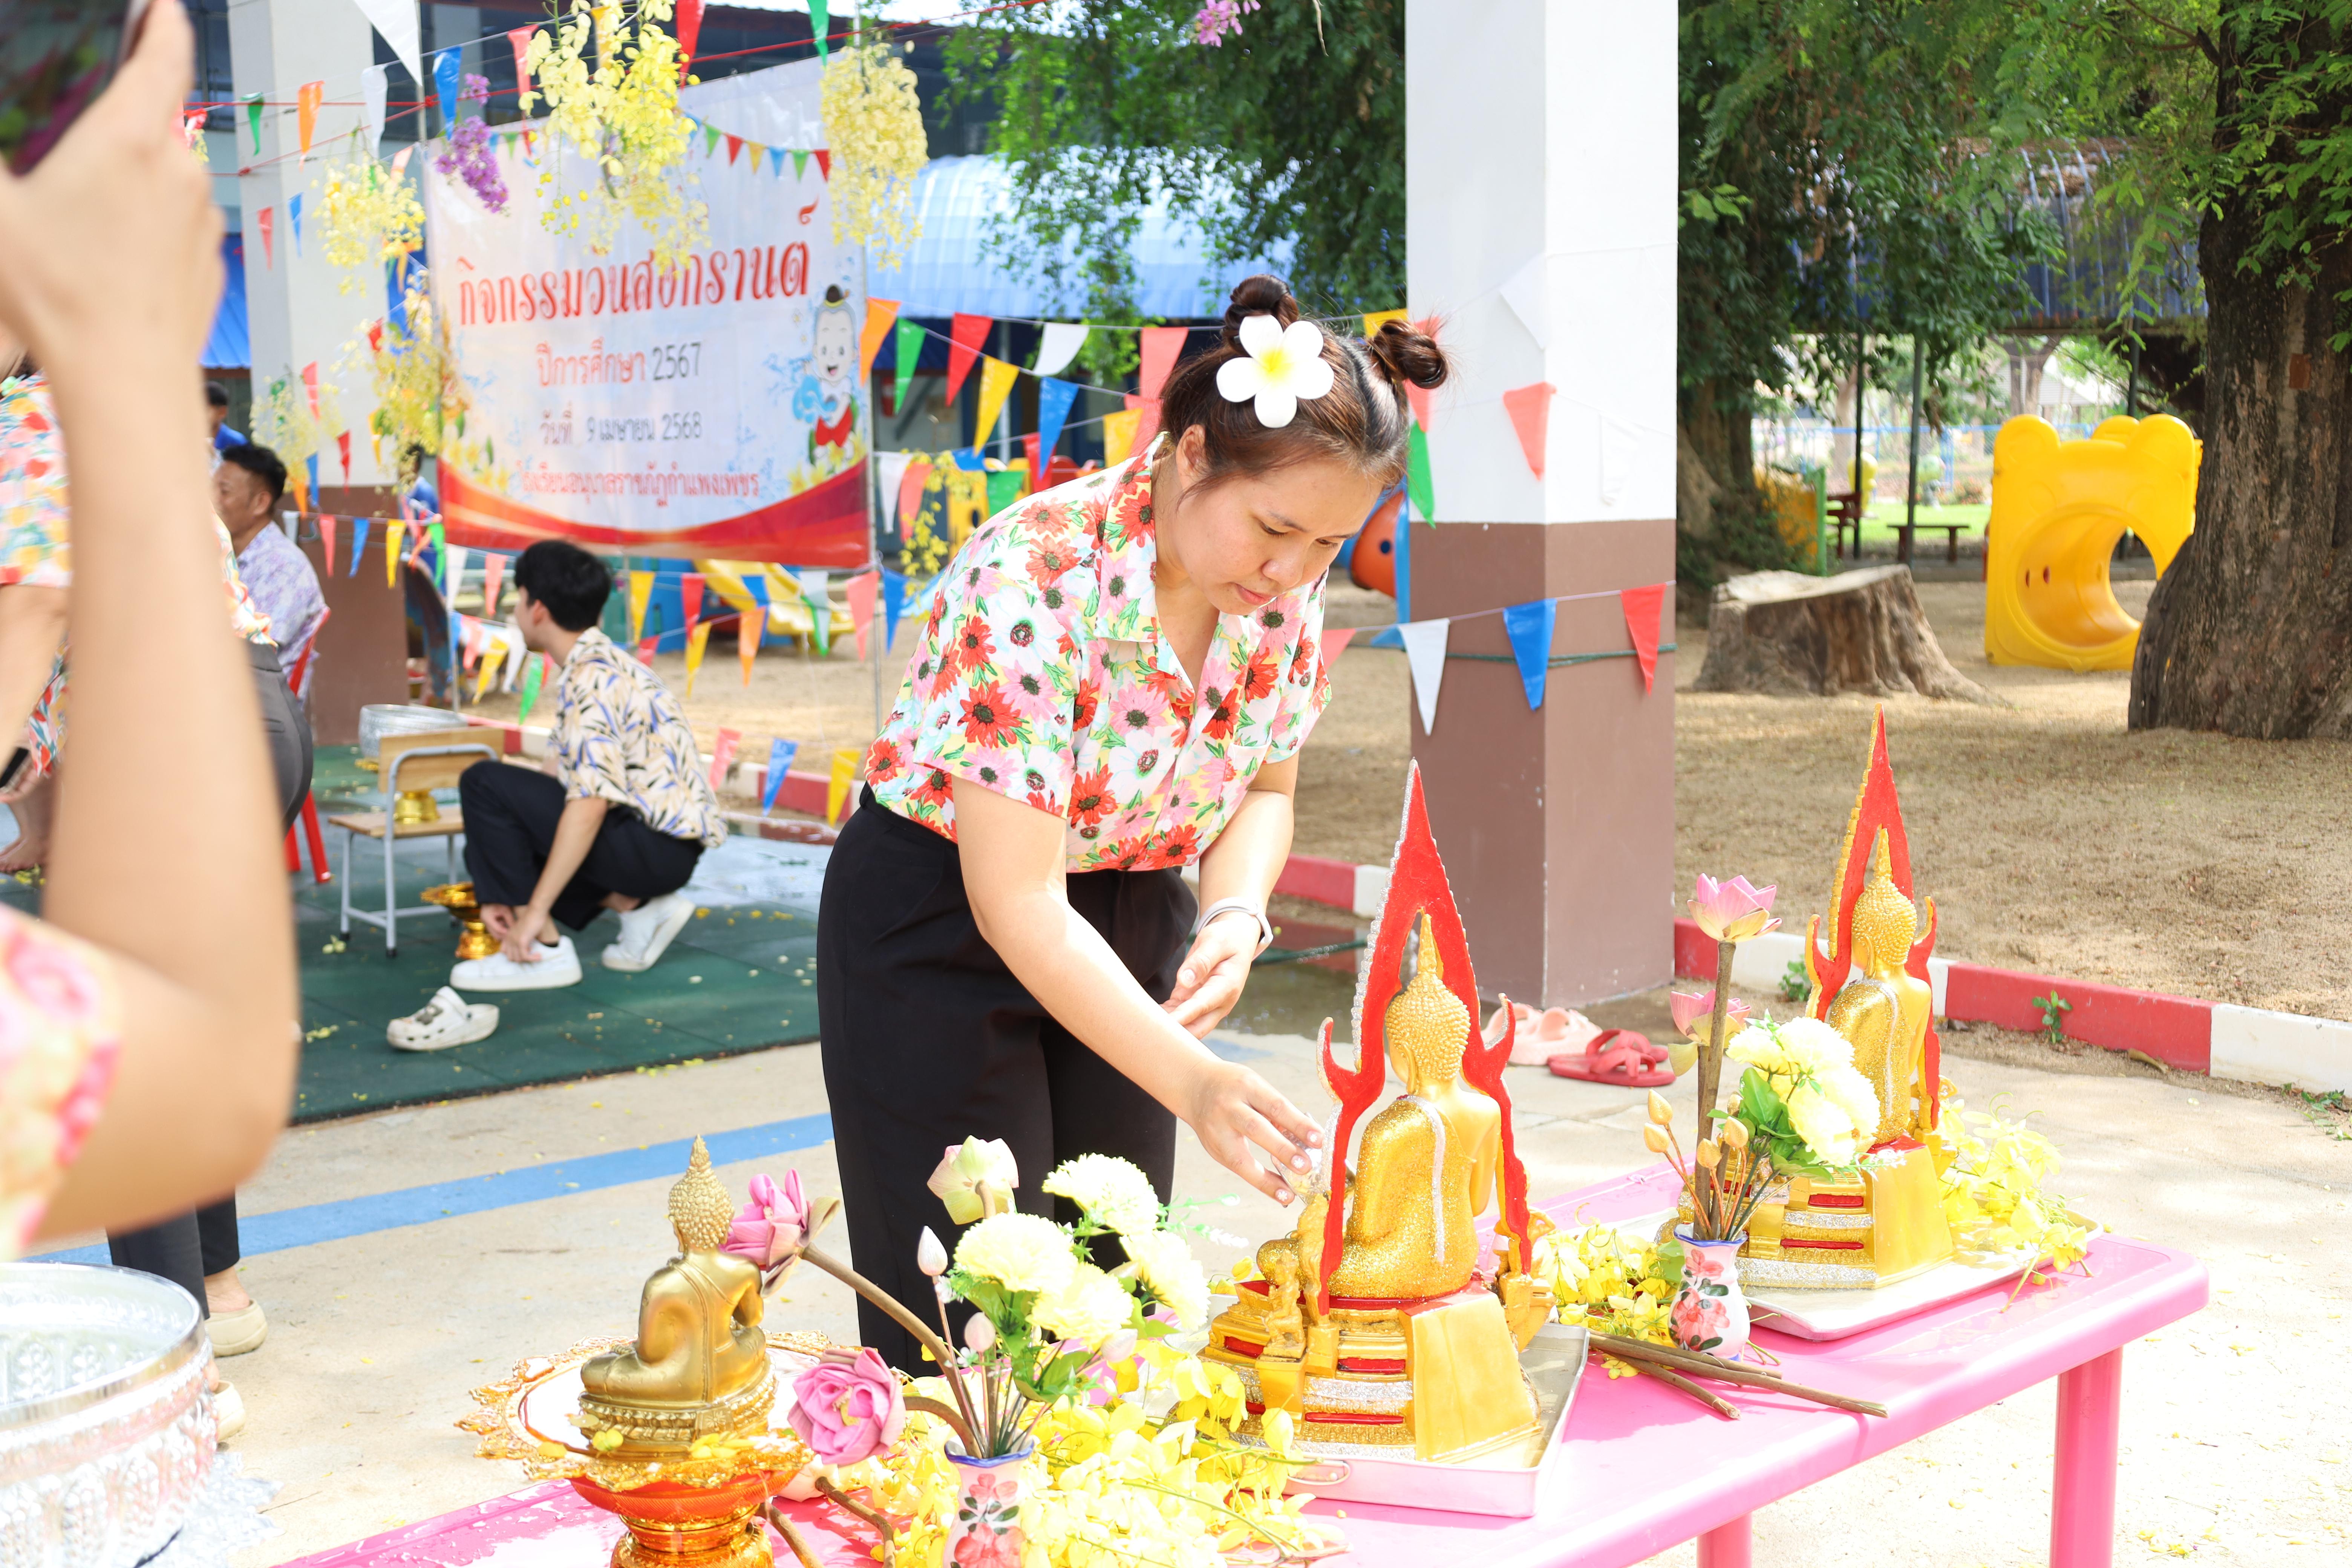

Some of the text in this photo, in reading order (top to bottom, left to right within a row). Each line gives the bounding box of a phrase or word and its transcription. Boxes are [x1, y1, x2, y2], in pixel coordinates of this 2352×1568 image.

[536, 337, 701, 386] ปีการศึกษา 2567
[540, 401, 703, 445] วันที่ 9 เมษายน 2568
